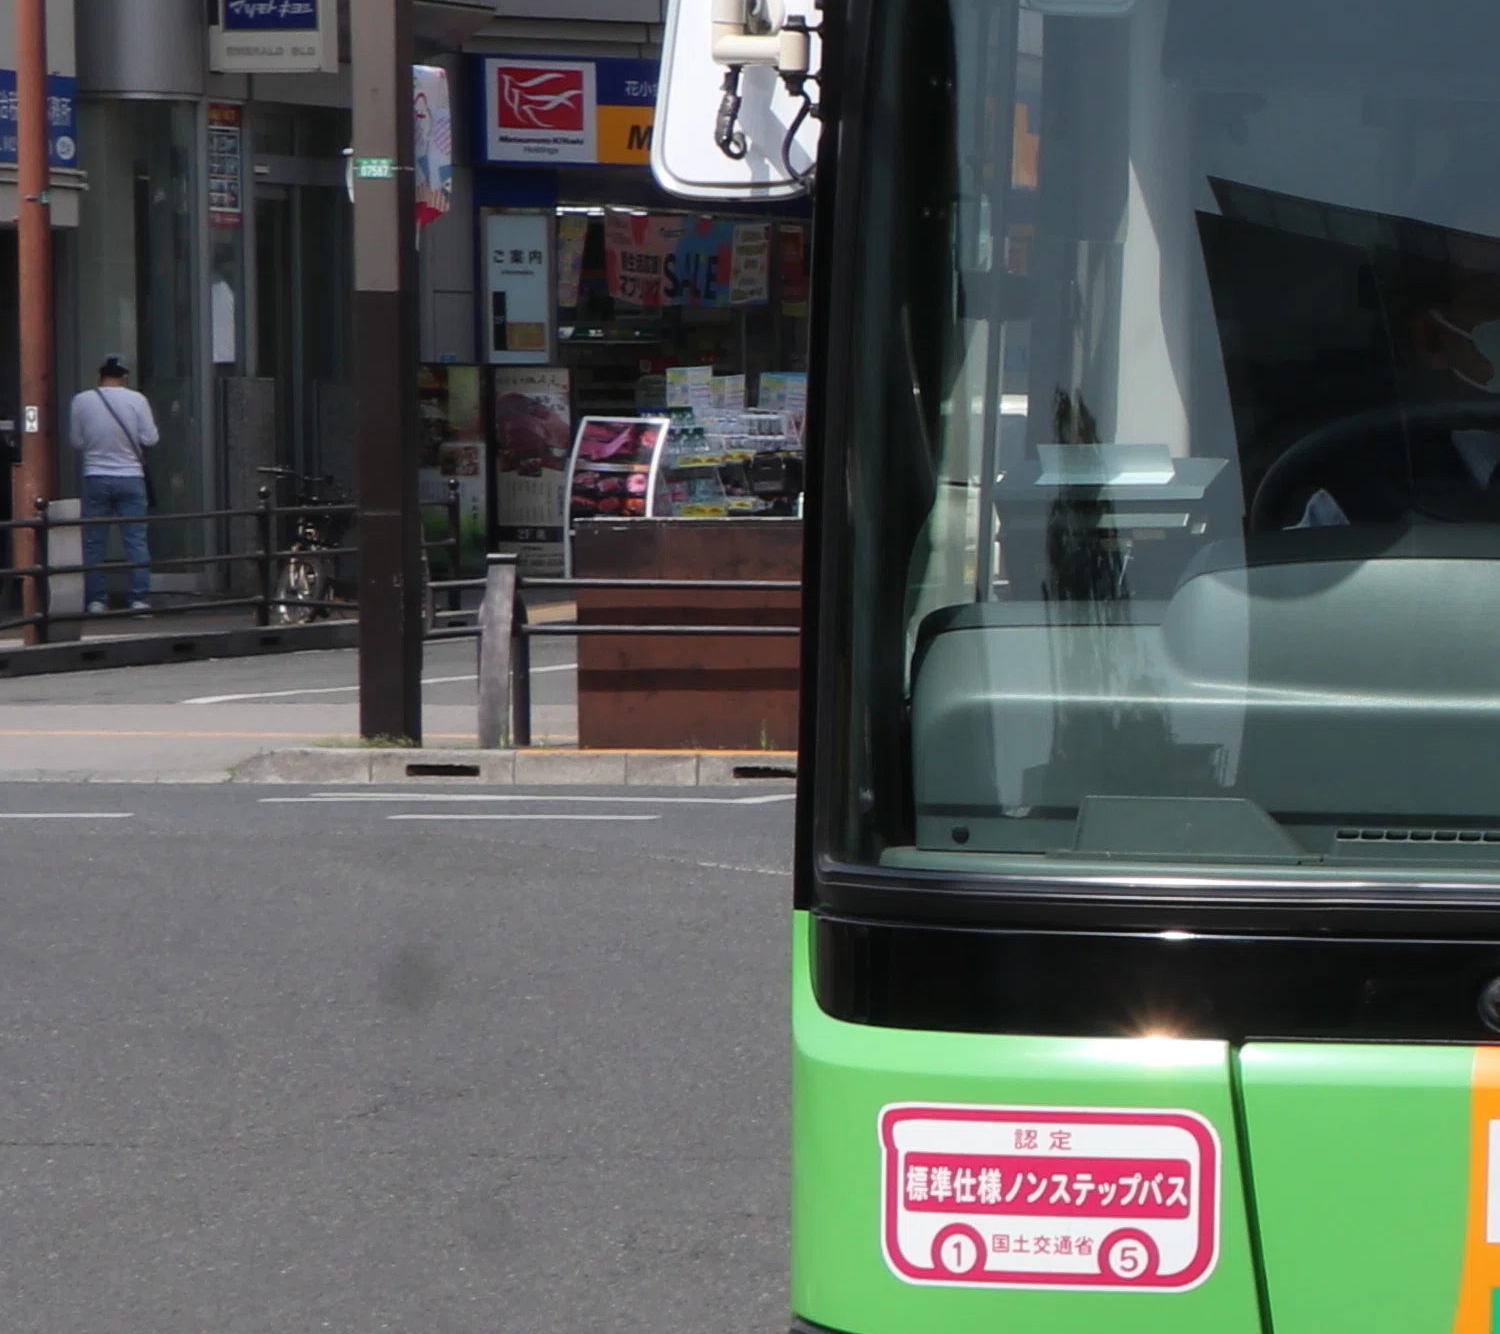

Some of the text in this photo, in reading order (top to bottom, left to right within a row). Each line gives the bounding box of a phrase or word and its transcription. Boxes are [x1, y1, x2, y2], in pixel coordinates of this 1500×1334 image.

[493, 249, 543, 265] ご案内
[1013, 1128, 1073, 1152] 認定
[905, 1164, 1189, 1208] 標準仕様ノンステップバス
[992, 1233, 1094, 1257] 国土交通省
